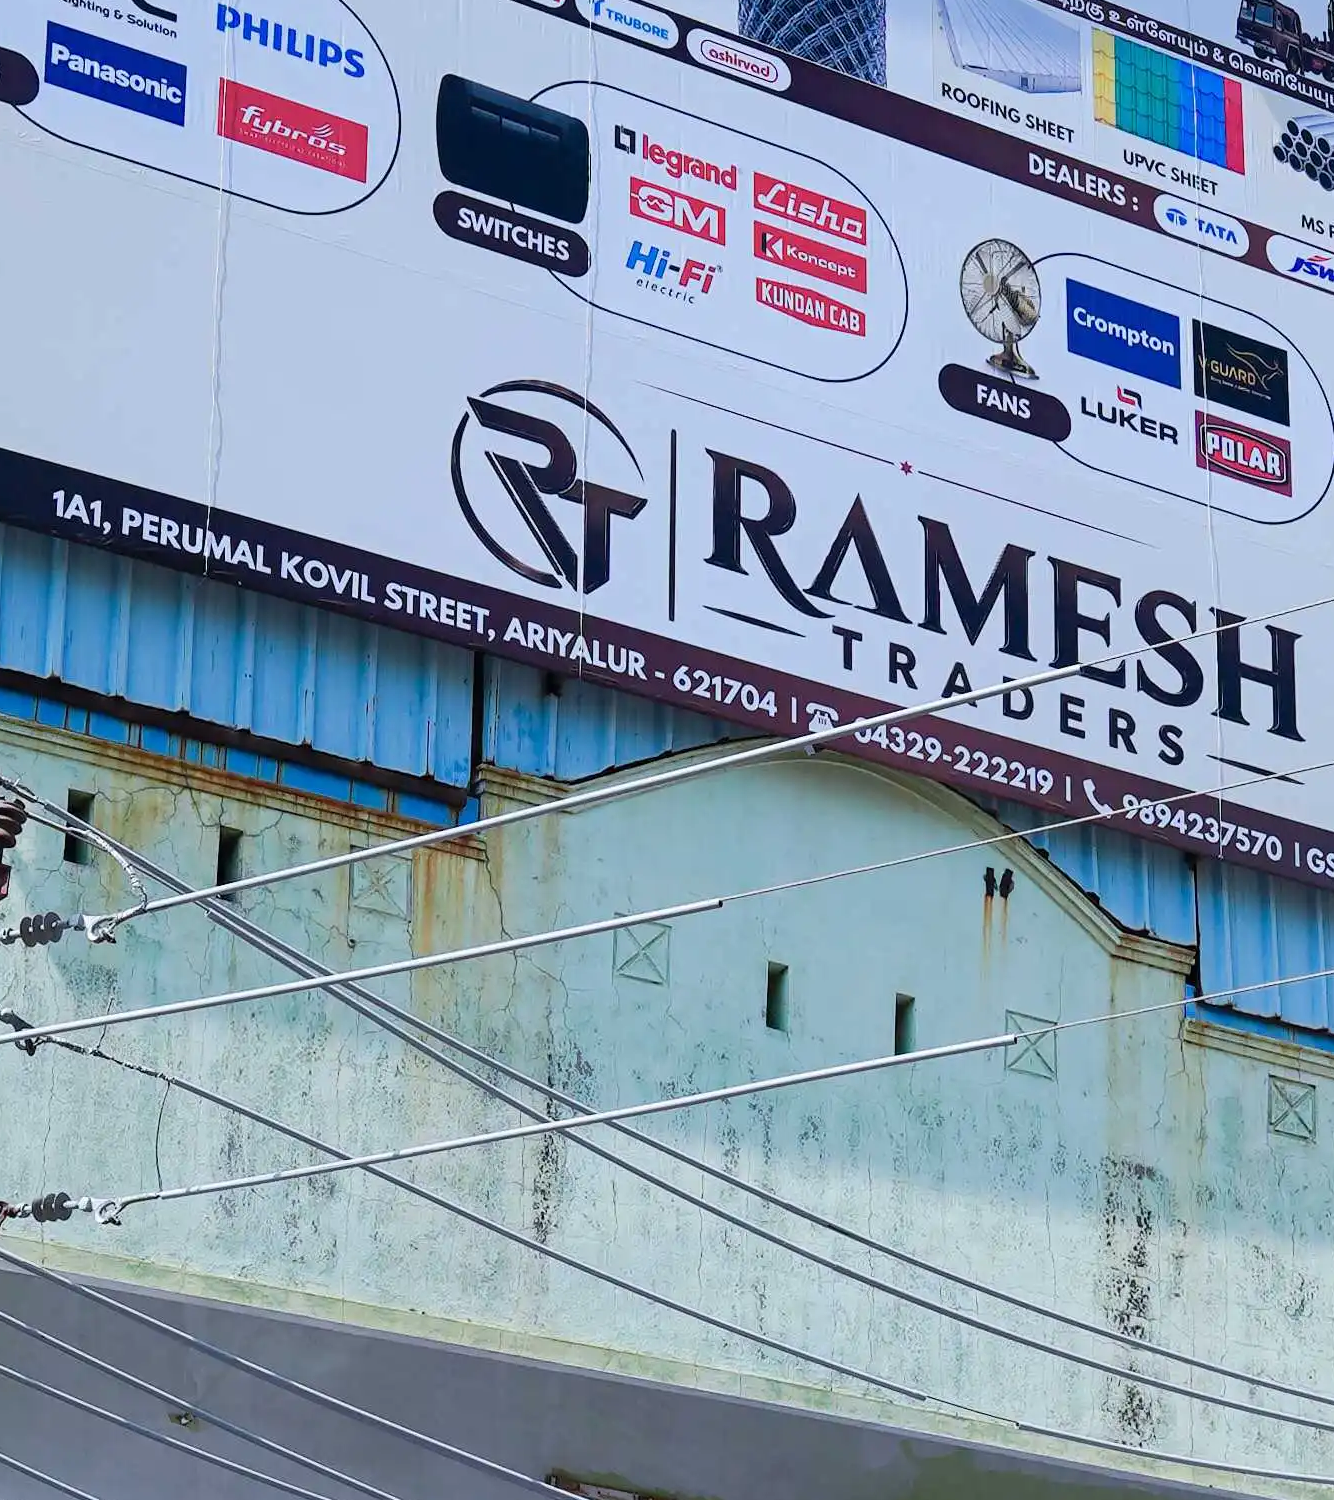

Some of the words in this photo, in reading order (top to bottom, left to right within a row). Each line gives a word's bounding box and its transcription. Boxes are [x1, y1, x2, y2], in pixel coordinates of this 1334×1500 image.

[113, 10, 124, 20] &
[127, 12, 178, 39] Solution
[217, 4, 365, 78] PHILIPS
[606, 8, 669, 40] TRUBORE
[51, 43, 182, 103] Panasonic
[708, 48, 770, 78] ashirvad
[1213, 48, 1225, 62] &
[941, 80, 1021, 123] ROOFING
[1025, 114, 1075, 143] SHEET
[642, 133, 738, 191] legrand
[1028, 152, 1126, 205] DEALERS
[1123, 149, 1165, 177] UPVC
[1171, 165, 1218, 196] SHEET
[458, 207, 571, 261] SWITCHES
[757, 183, 864, 238] Lisha
[1195, 217, 1239, 244] TATA
[1301, 214, 1324, 236] MS
[625, 241, 718, 294] Hi-Fi
[787, 247, 856, 279] Koncept
[636, 277, 695, 305] electric
[760, 282, 825, 322] KUNDAN
[829, 306, 861, 333] CAB
[1073, 307, 1175, 357] Crompton
[976, 383, 1032, 419] FANS
[1081, 395, 1179, 445] LUKER
[1206, 433, 1282, 477] POLAR
[704, 446, 1308, 743] RAMESH
[52, 489, 112, 536] 1A1,
[121, 506, 272, 575] PERUMAL
[279, 550, 377, 605] KOVIL
[384, 582, 496, 642] STREET,
[504, 616, 647, 681] ARIYALUR
[673, 664, 778, 719] 621704
[1122, 793, 1283, 862] 9894237570
[833, 624, 1187, 766] TRADERS
